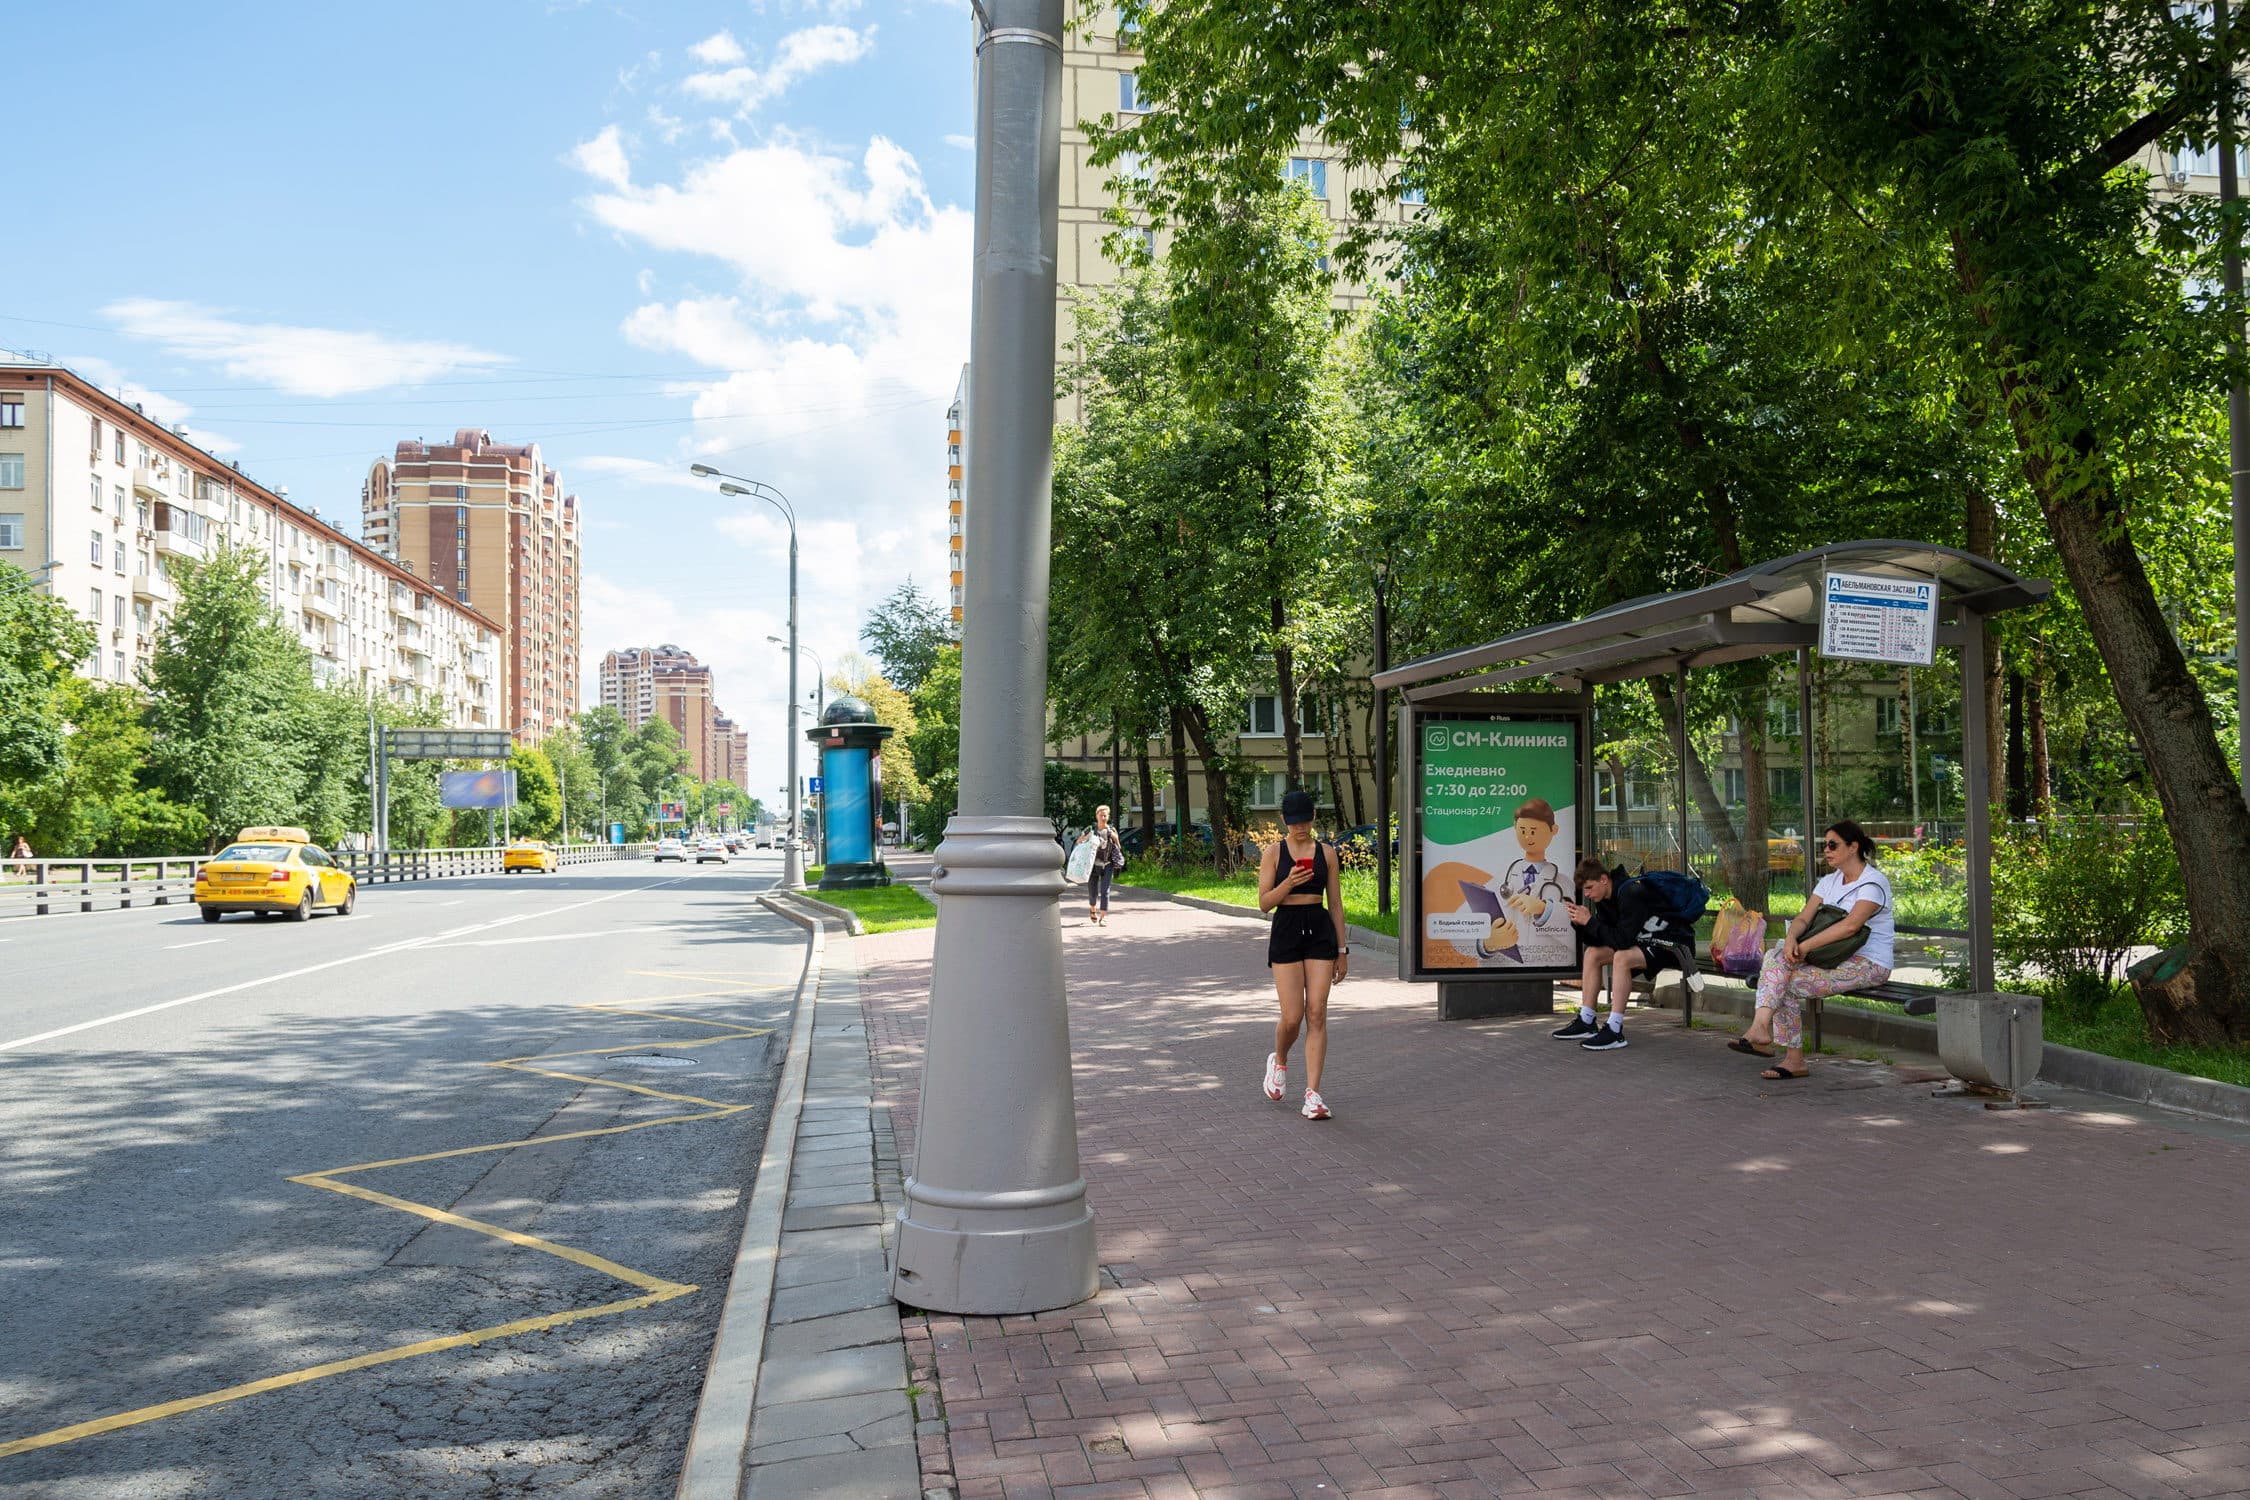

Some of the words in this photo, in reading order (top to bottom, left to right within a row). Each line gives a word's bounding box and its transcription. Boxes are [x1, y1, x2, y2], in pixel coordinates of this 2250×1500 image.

[1841, 580, 1891, 592] АБЕЛЬМАНОВСКАЯ
[1892, 585, 1916, 594] ЗАСТАВА
[1452, 731, 1568, 748] СМ-Клиника
[1425, 763, 1506, 778] Ежедневно
[1425, 785, 1433, 796] с
[1436, 784, 1466, 796] 7:30
[1468, 786, 1487, 797] до
[1489, 784, 1527, 796] 22:00
[1425, 805, 1478, 816] Стационар
[1480, 806, 1501, 816] 24/7
